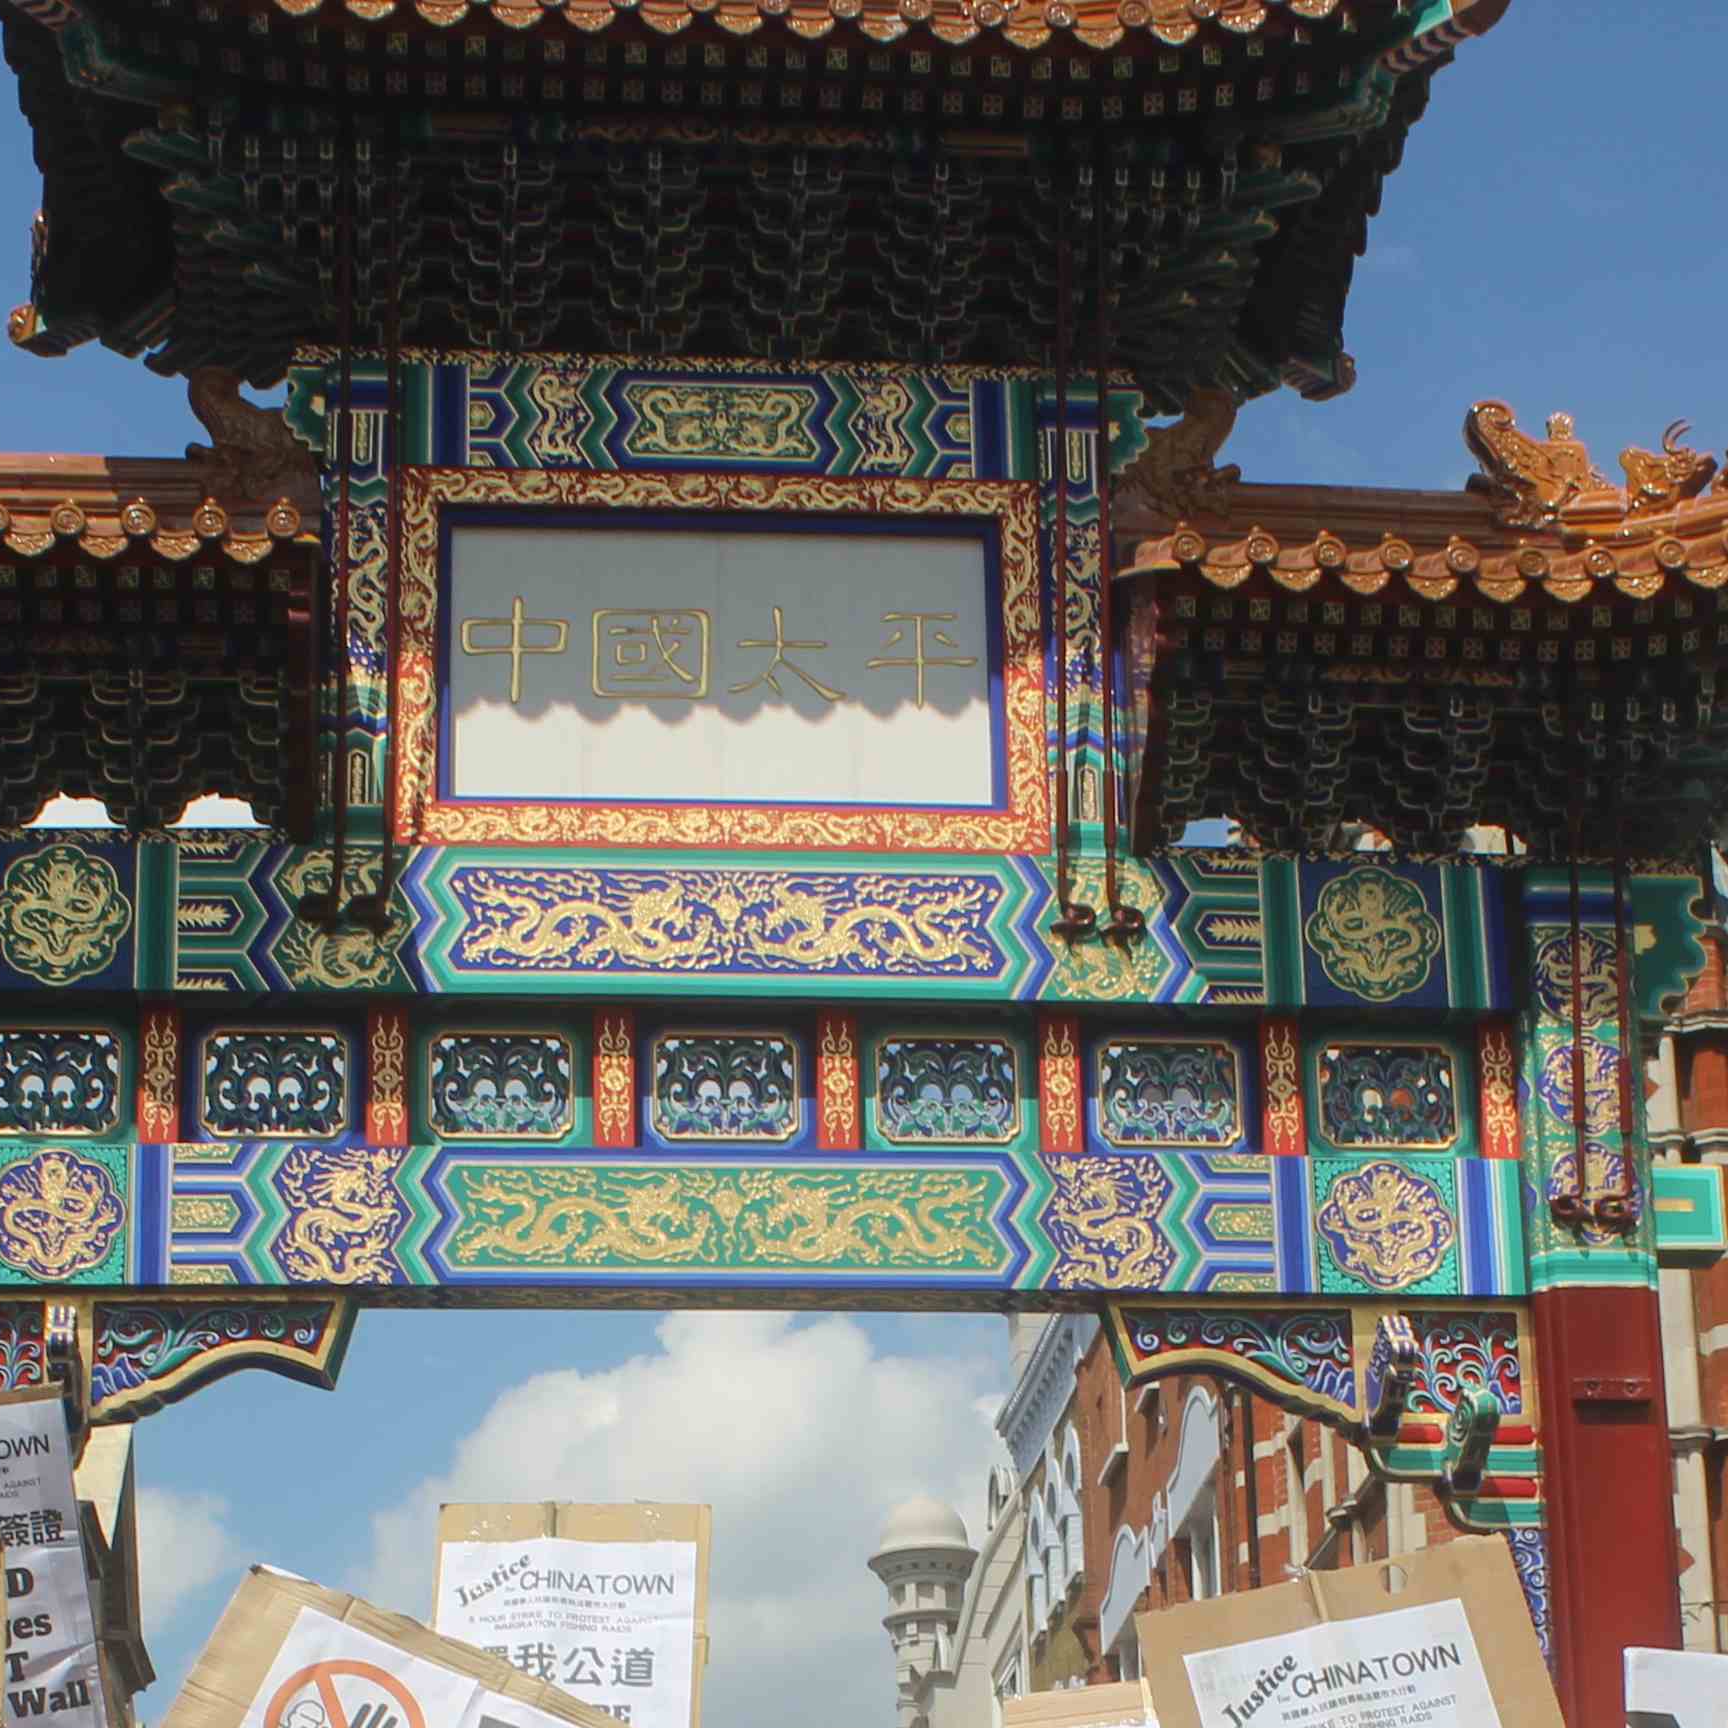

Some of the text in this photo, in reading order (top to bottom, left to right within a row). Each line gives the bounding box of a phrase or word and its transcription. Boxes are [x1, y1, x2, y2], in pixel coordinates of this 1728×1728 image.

[461, 595, 977, 708] 中國太平
[453, 1554, 531, 1608] Justice
[520, 1570, 674, 1596] CHINATOWN
[1292, 1643, 1461, 1698] CHINATOWN
[1360, 1706, 1407, 1722] PROTEST
[1412, 1694, 1458, 1712] AGAINST
